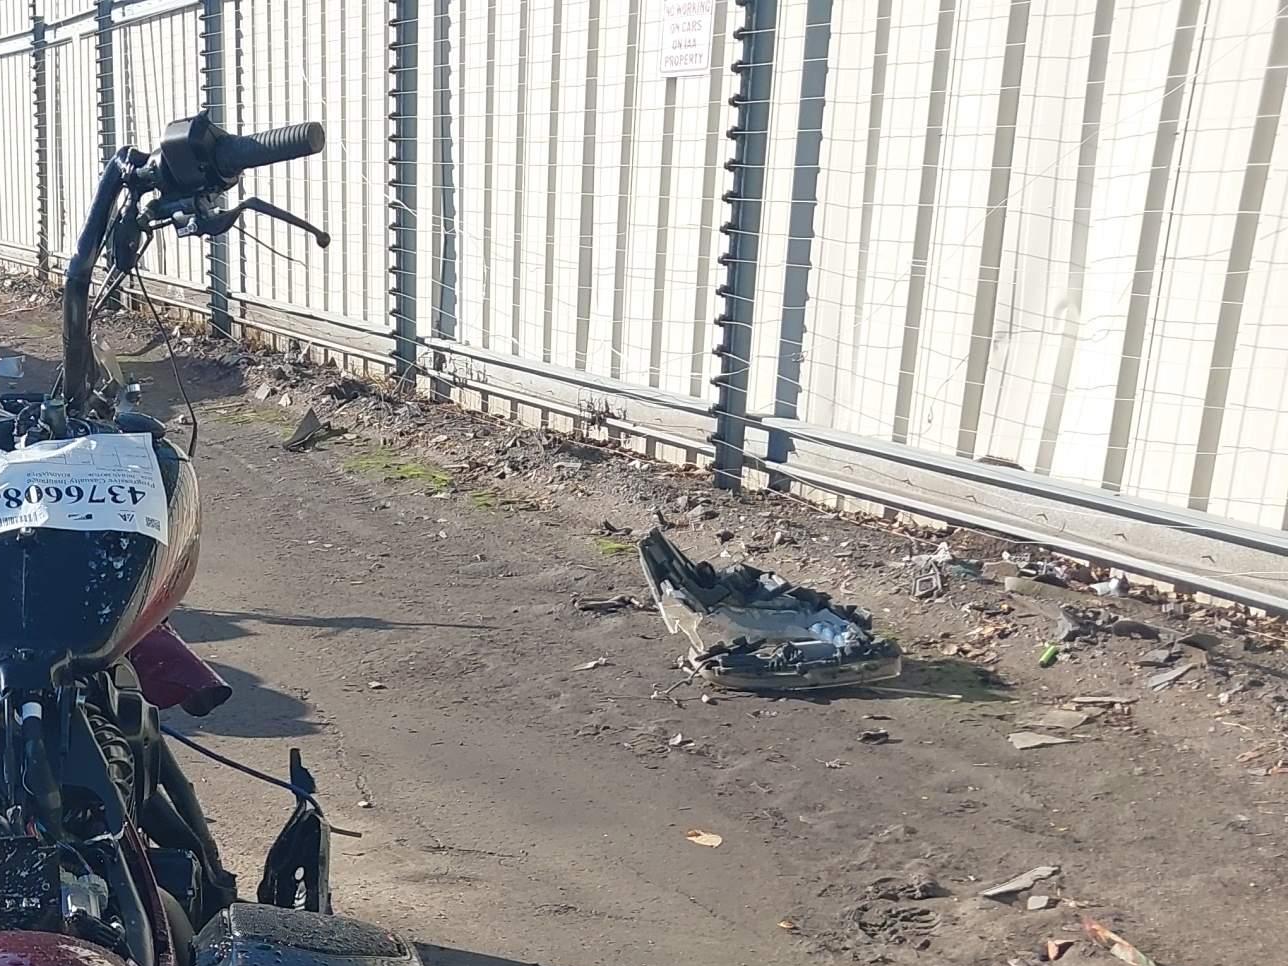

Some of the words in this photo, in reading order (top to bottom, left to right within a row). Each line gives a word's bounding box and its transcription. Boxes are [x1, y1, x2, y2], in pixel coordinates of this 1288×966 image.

[682, 19, 703, 32] CARS
[672, 39, 682, 49] ON
[664, 53, 703, 67] PROPERTY
[69, 478, 106, 486] Casualty
[108, 478, 156, 489] Progressive
